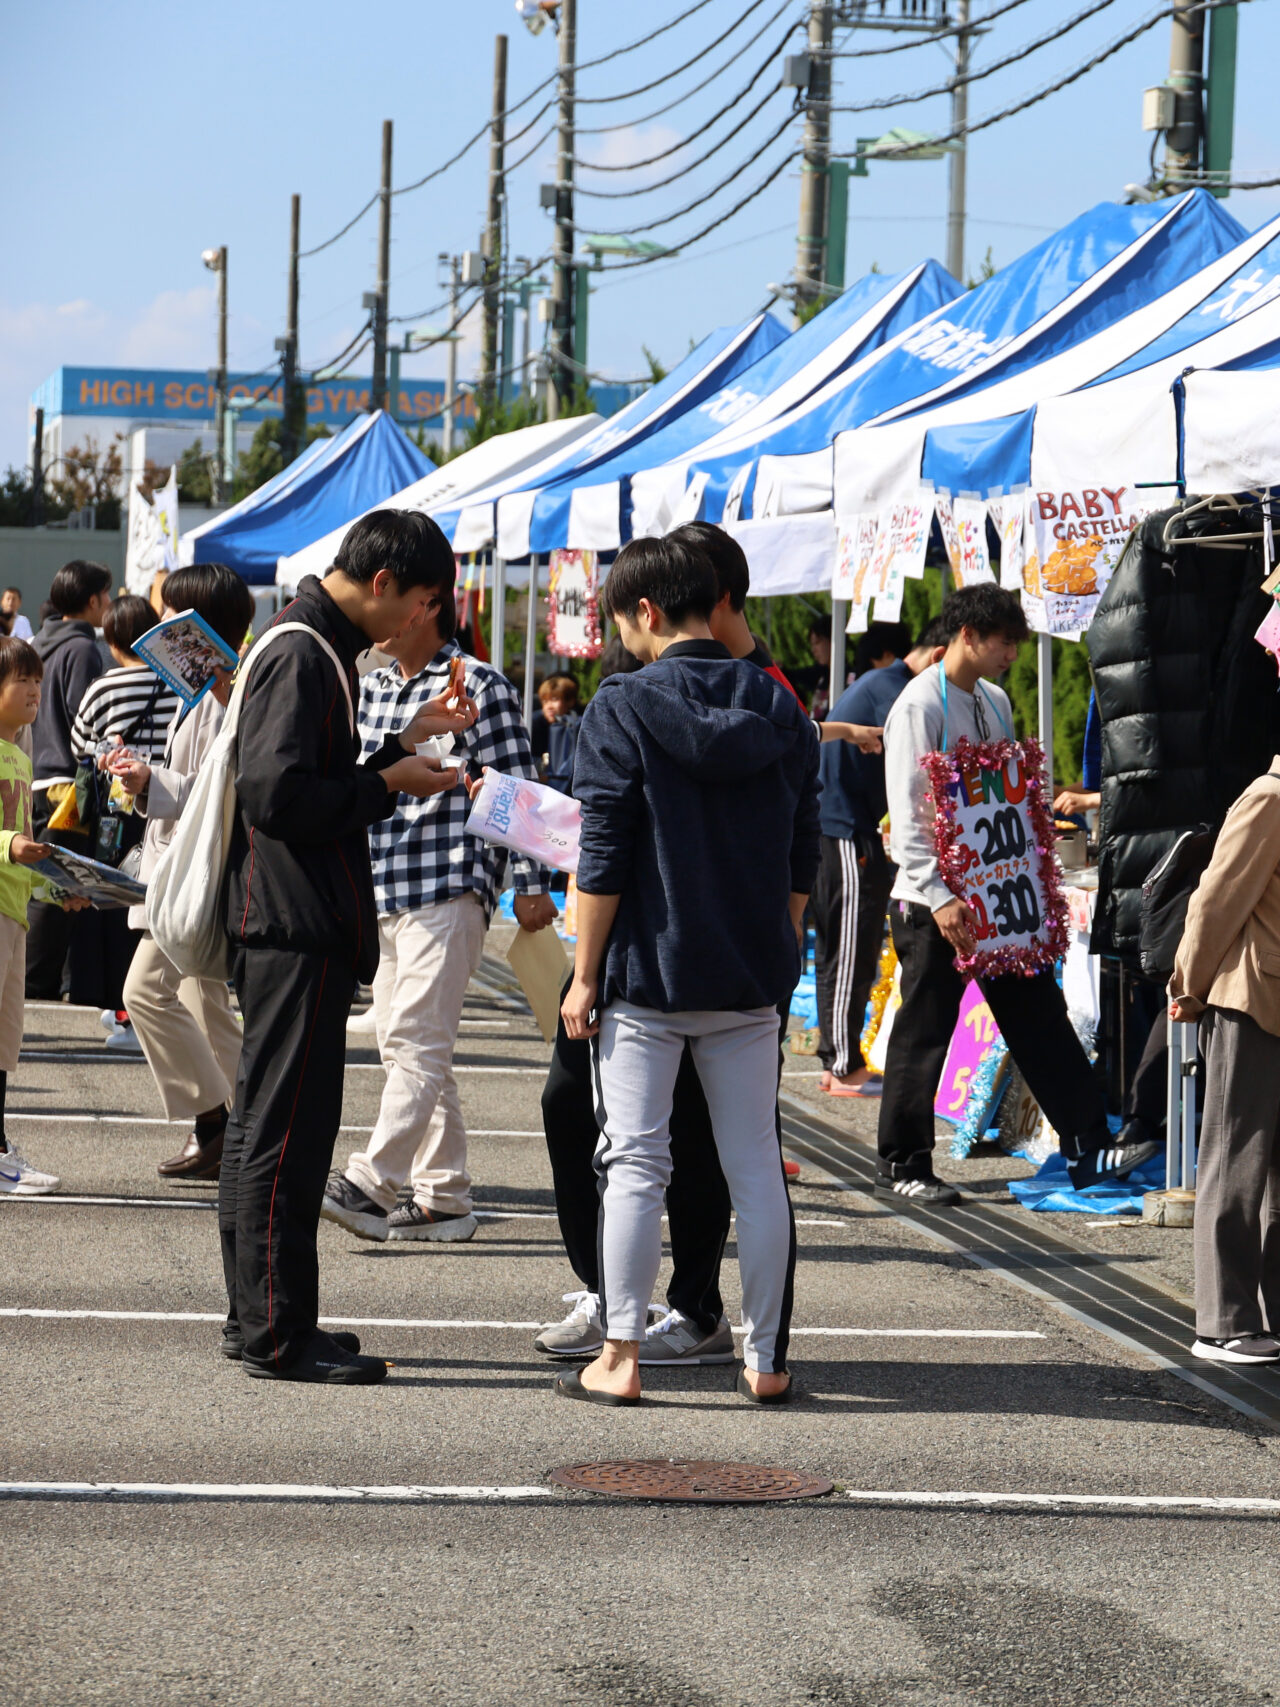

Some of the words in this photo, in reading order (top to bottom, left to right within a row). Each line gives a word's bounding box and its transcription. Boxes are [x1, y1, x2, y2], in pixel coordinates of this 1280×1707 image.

[79, 379, 155, 407] HIGH
[1037, 486, 1127, 521] BABY
[1053, 514, 1139, 541] CASTELLA
[948, 760, 1027, 808] MENU
[543, 830, 568, 847] 300
[964, 857, 1031, 889] ベビーカステラ
